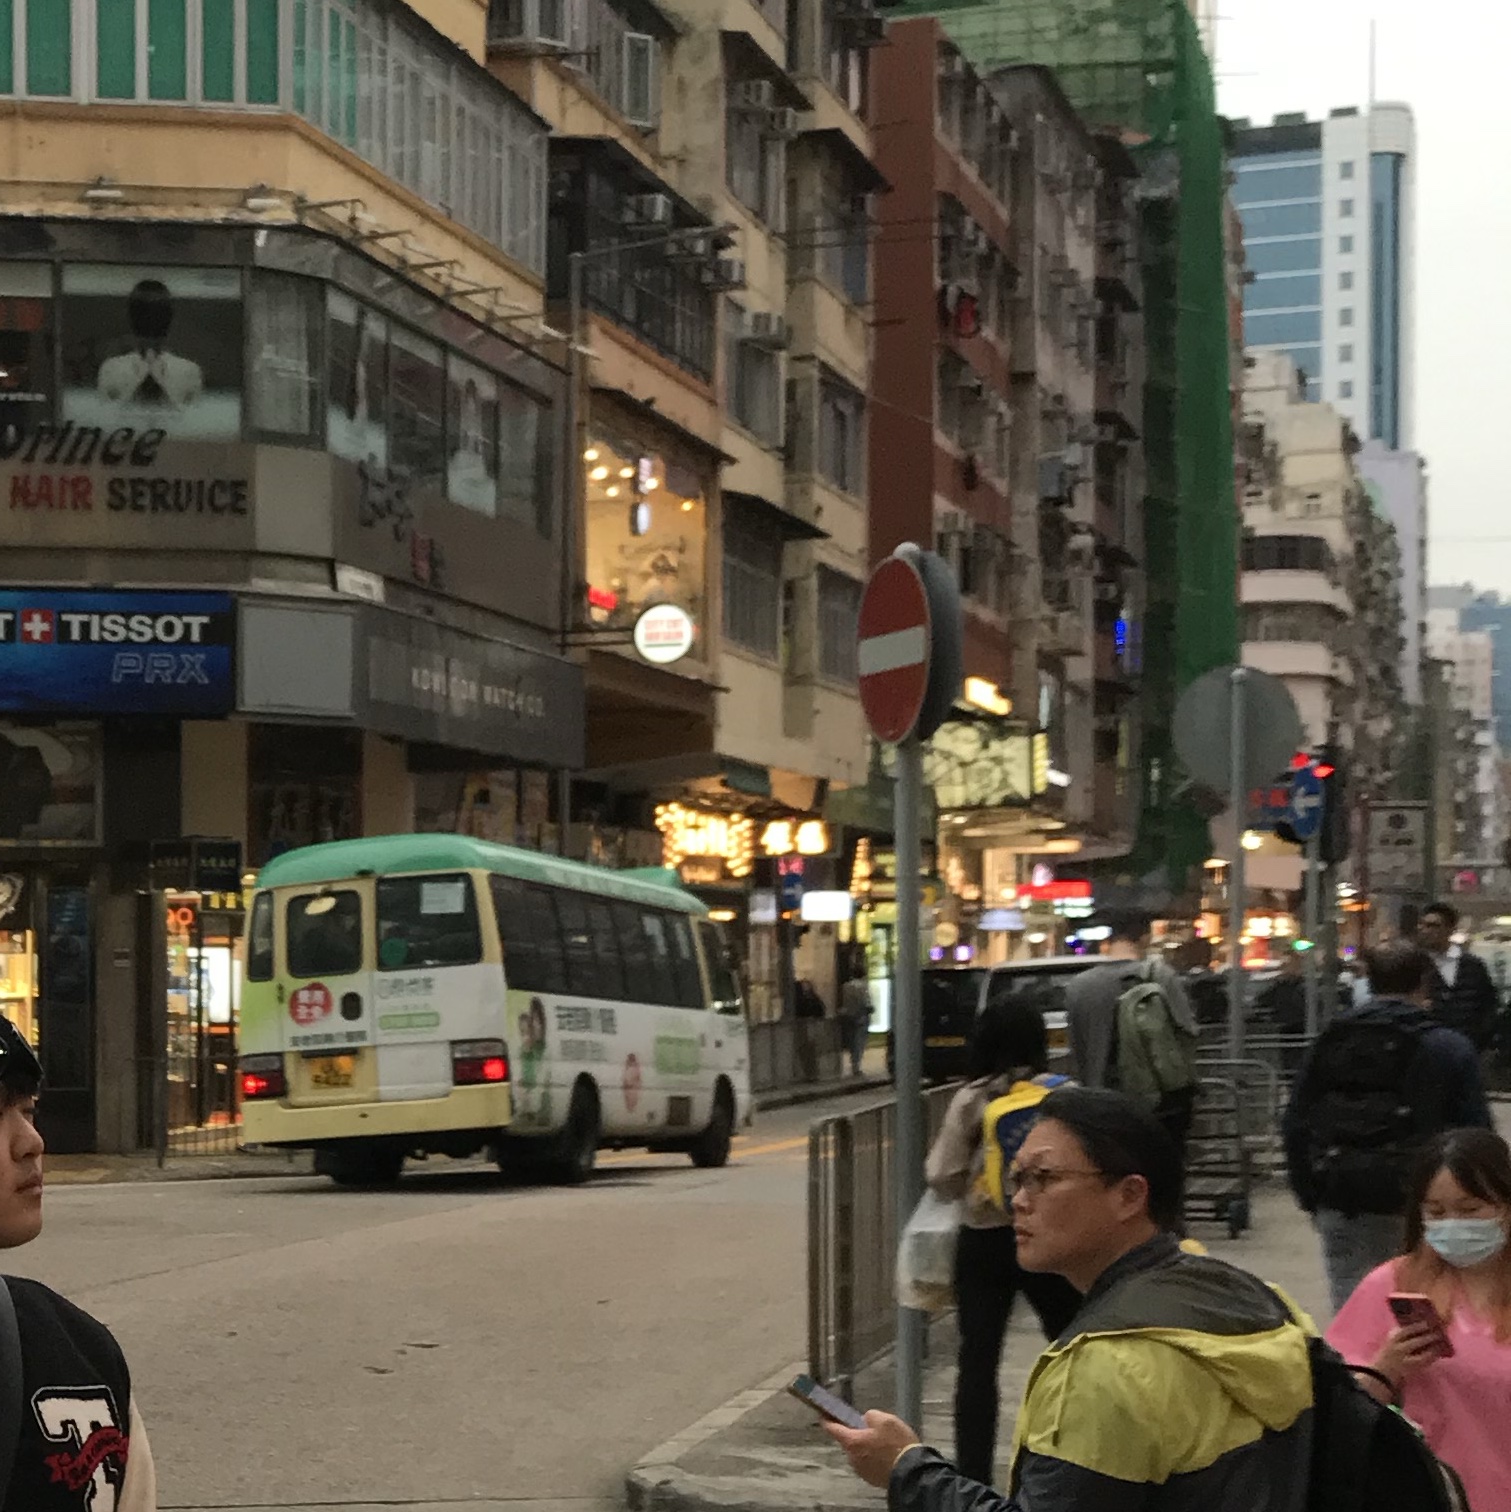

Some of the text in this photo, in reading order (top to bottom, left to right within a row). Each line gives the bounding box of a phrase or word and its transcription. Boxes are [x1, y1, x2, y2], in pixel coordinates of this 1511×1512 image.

[10, 475, 248, 514] HAIR SERVICE
[61, 613, 211, 642] TISSOT
[110, 653, 211, 684] PRX
